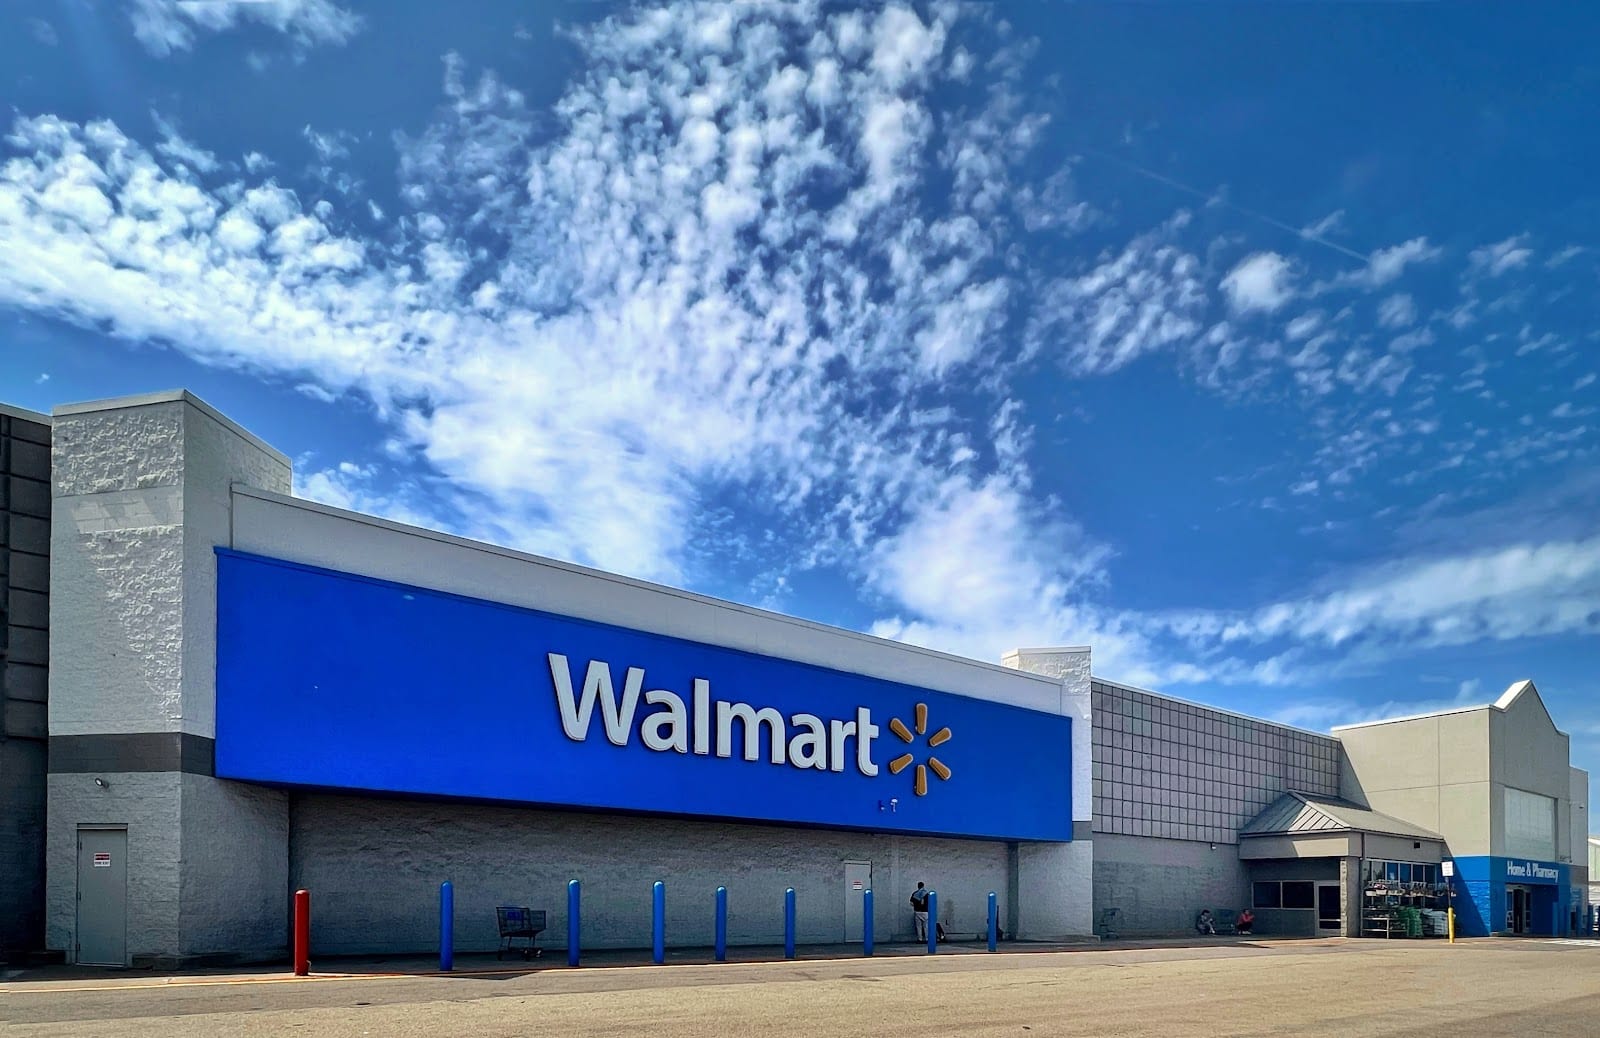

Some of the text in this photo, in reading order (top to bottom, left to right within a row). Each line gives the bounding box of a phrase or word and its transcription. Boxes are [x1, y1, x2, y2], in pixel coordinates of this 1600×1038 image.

[548, 652, 880, 777] Walmart
[1507, 860, 1559, 883] Home & Pharmacy
